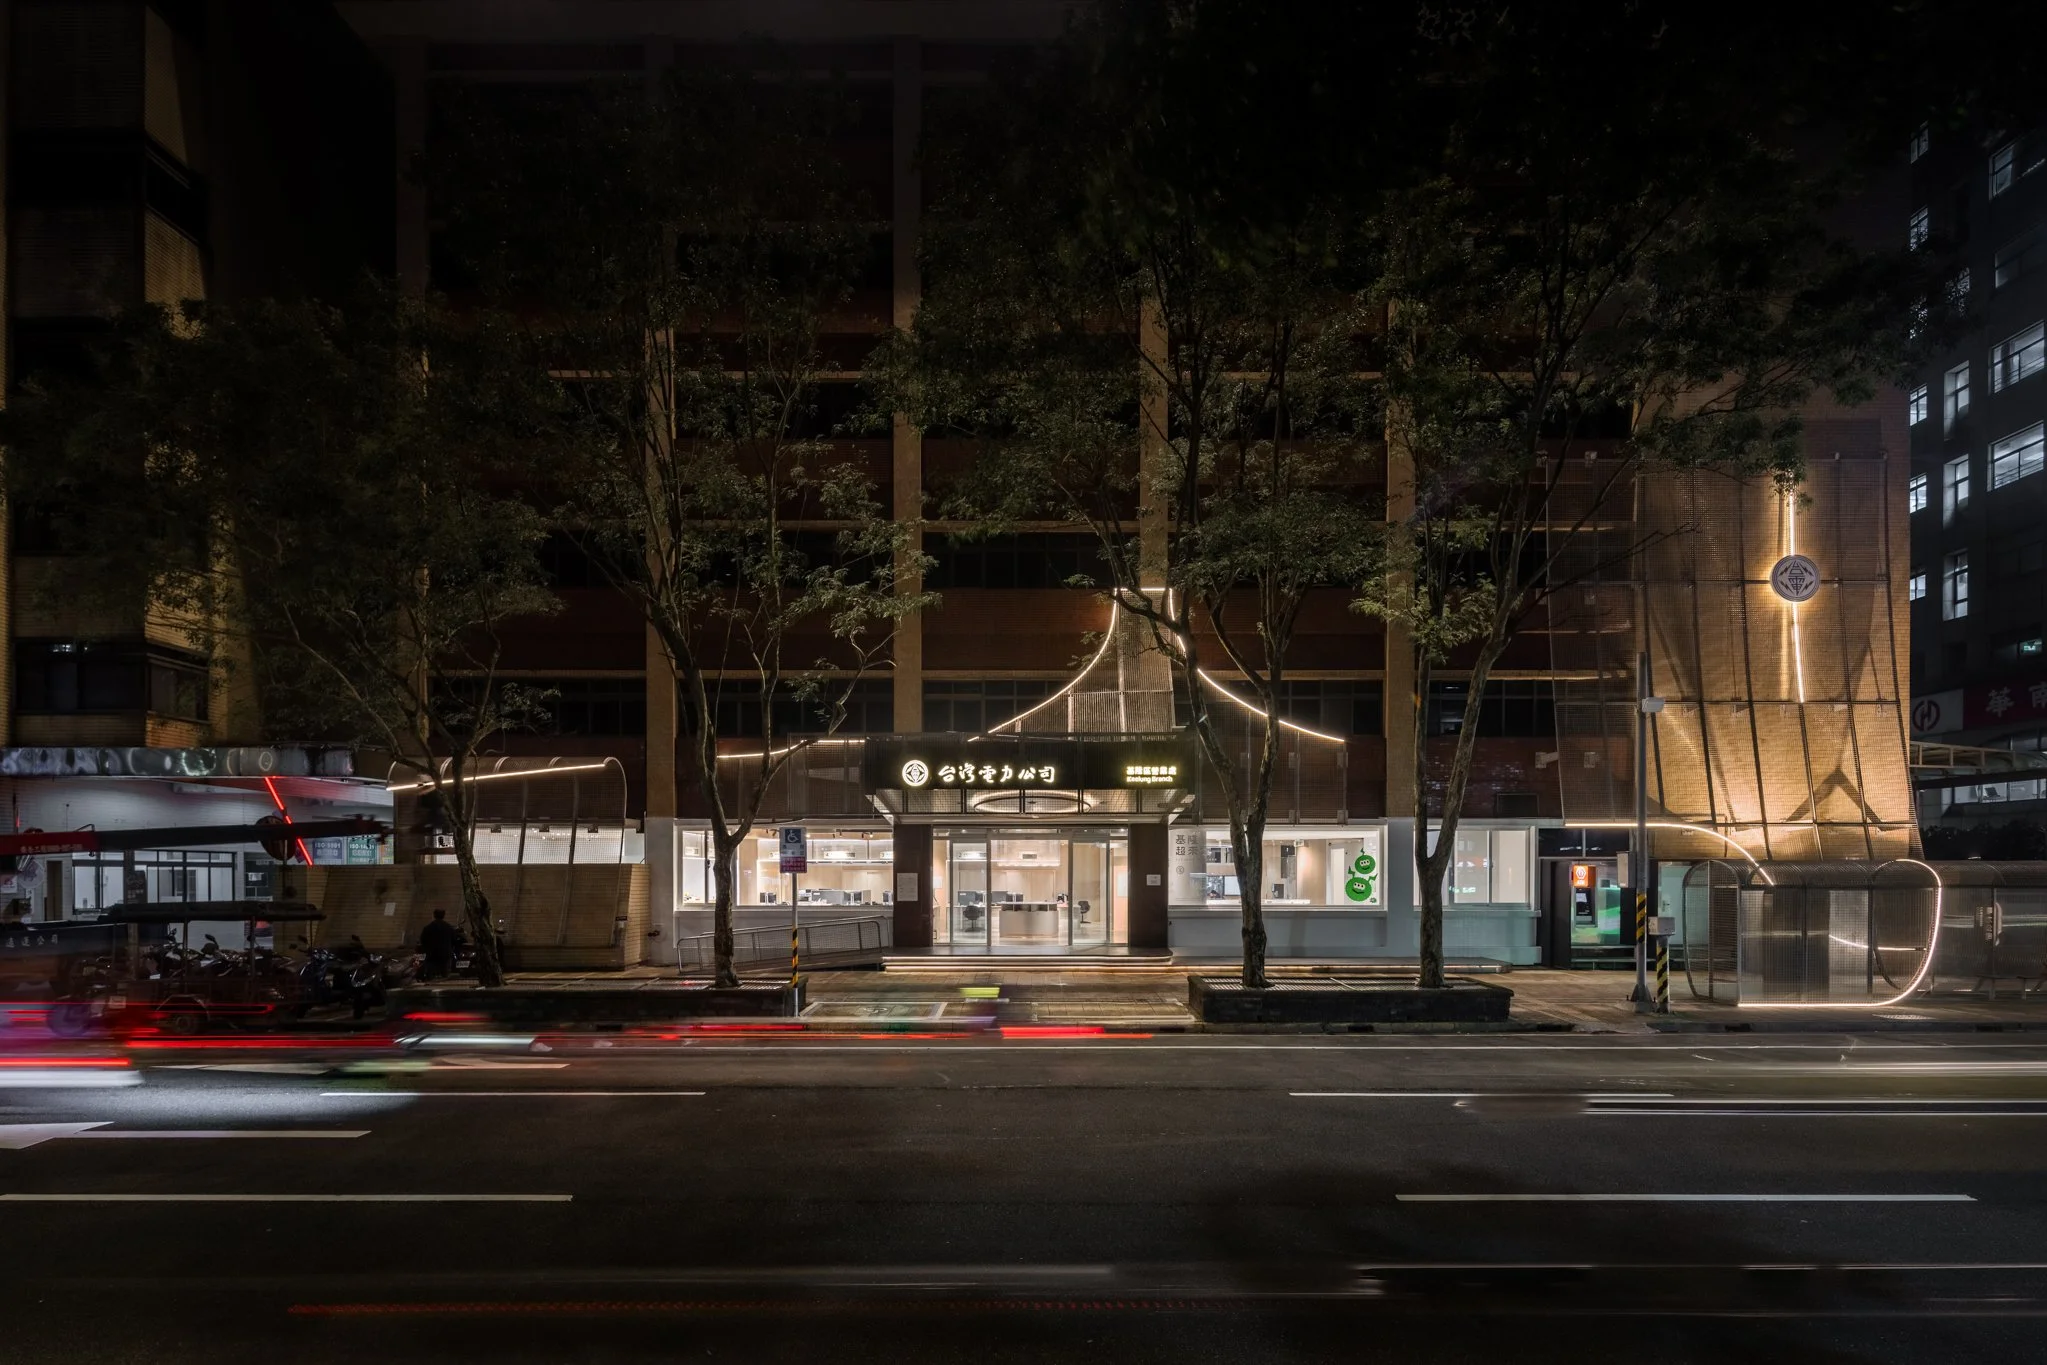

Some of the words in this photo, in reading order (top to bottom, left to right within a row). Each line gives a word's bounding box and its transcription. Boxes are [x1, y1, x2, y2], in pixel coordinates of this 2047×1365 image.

[938, 763, 1055, 783] 台灣電力公司
[1126, 776, 1151, 784] Keelung
[1176, 834, 1199, 845] 基隆
